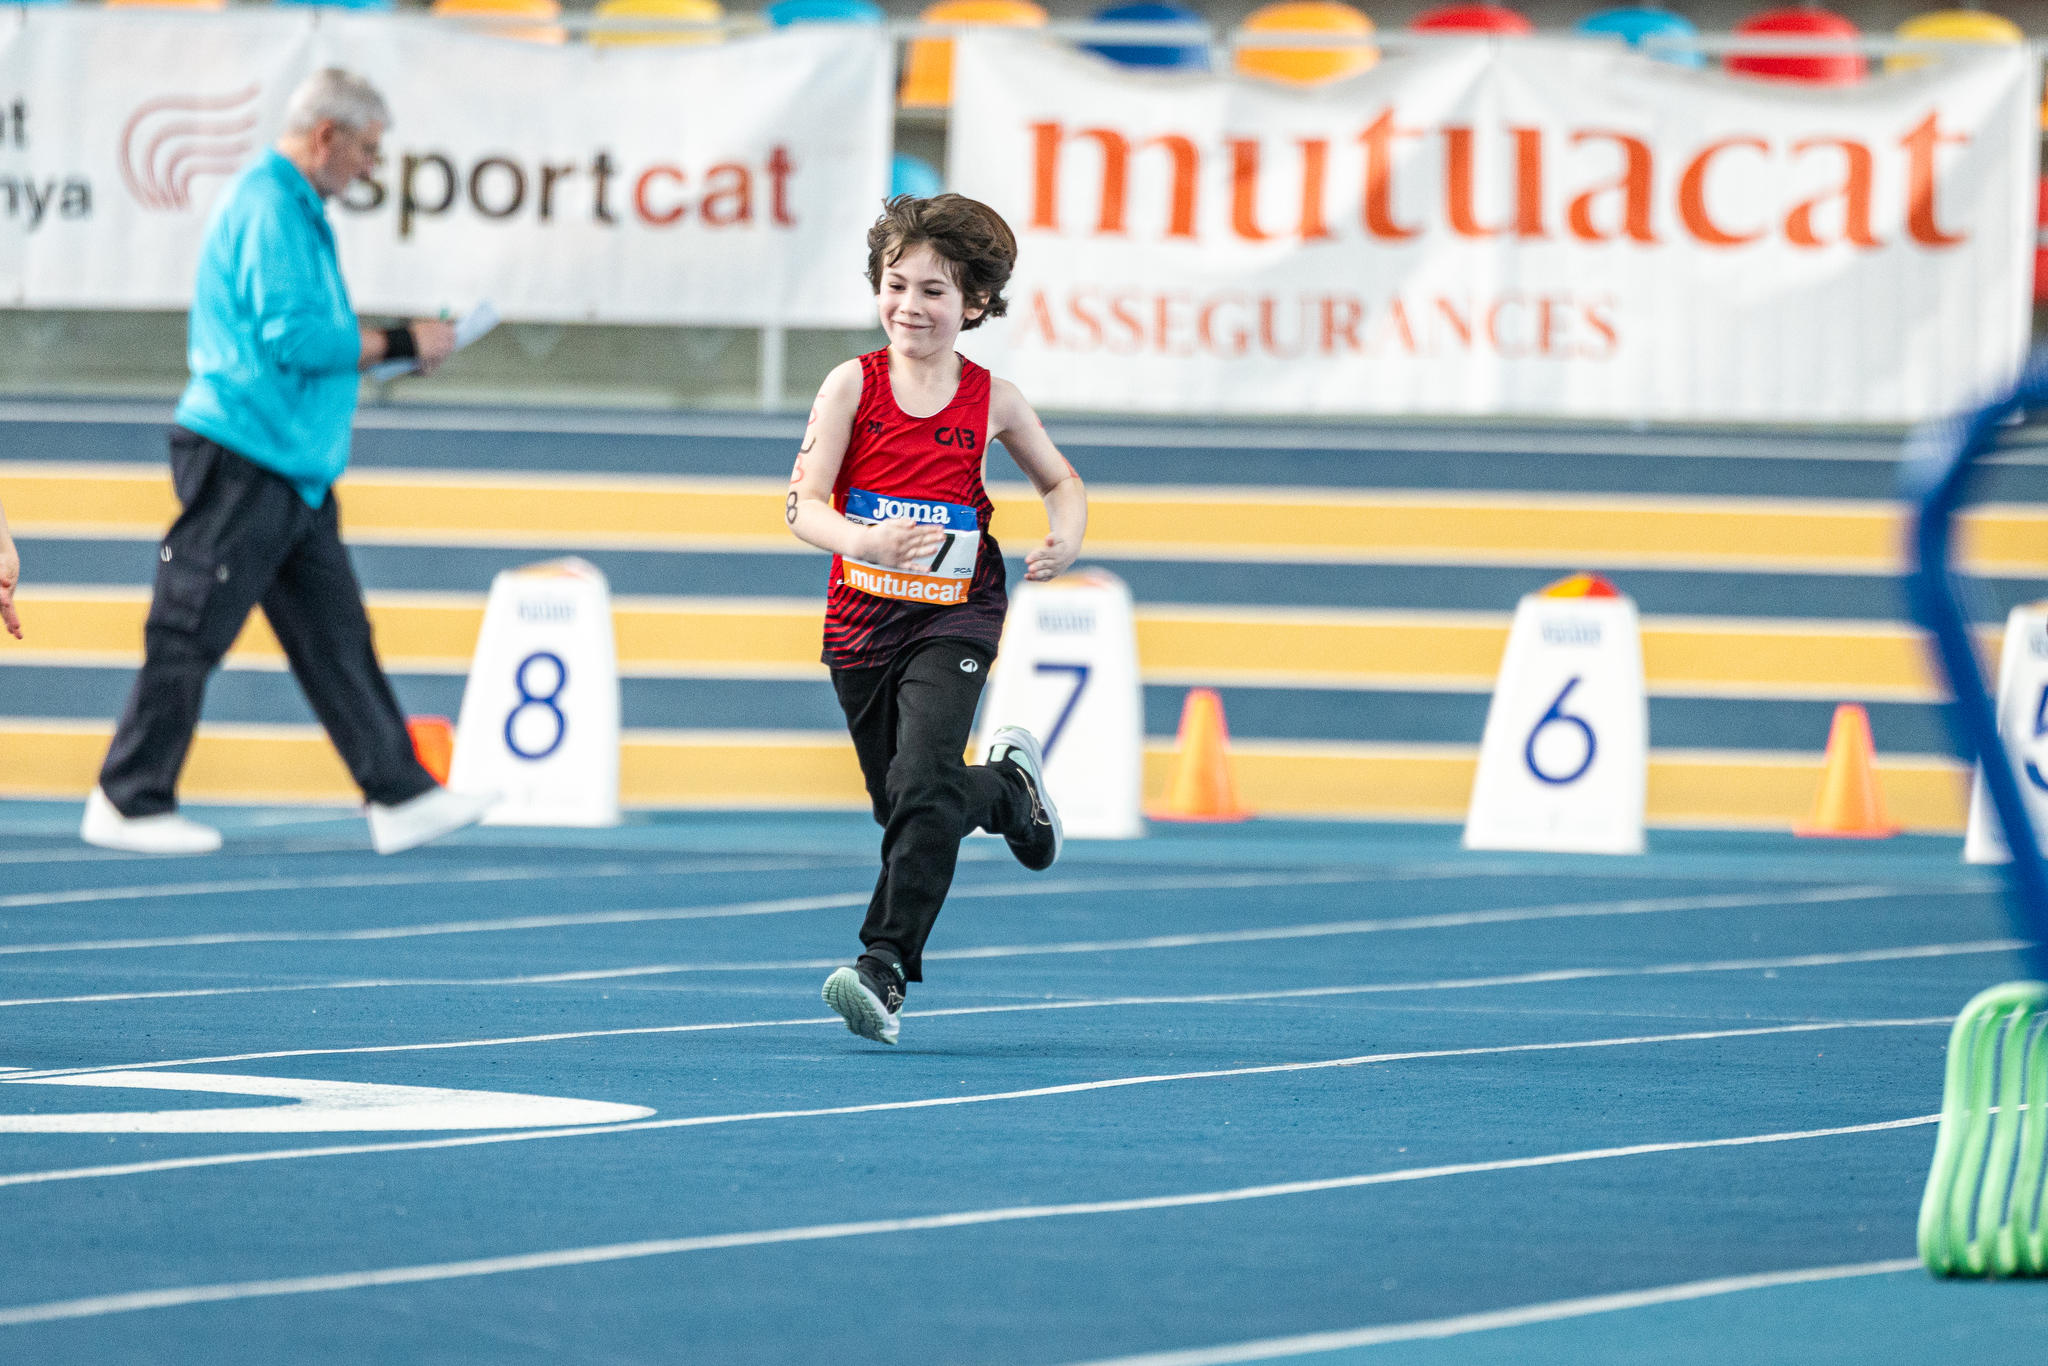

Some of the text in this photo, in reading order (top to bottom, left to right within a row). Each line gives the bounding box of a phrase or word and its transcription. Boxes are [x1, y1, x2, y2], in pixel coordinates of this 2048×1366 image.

[333, 144, 796, 240] sportcat
[1022, 106, 1971, 250] mutuacat
[1014, 286, 1622, 361] ASSEGURANCES
[850, 568, 963, 602] mutuacat
[504, 650, 567, 761] 8
[1034, 660, 1092, 768] 7
[1525, 673, 1597, 786] 6
